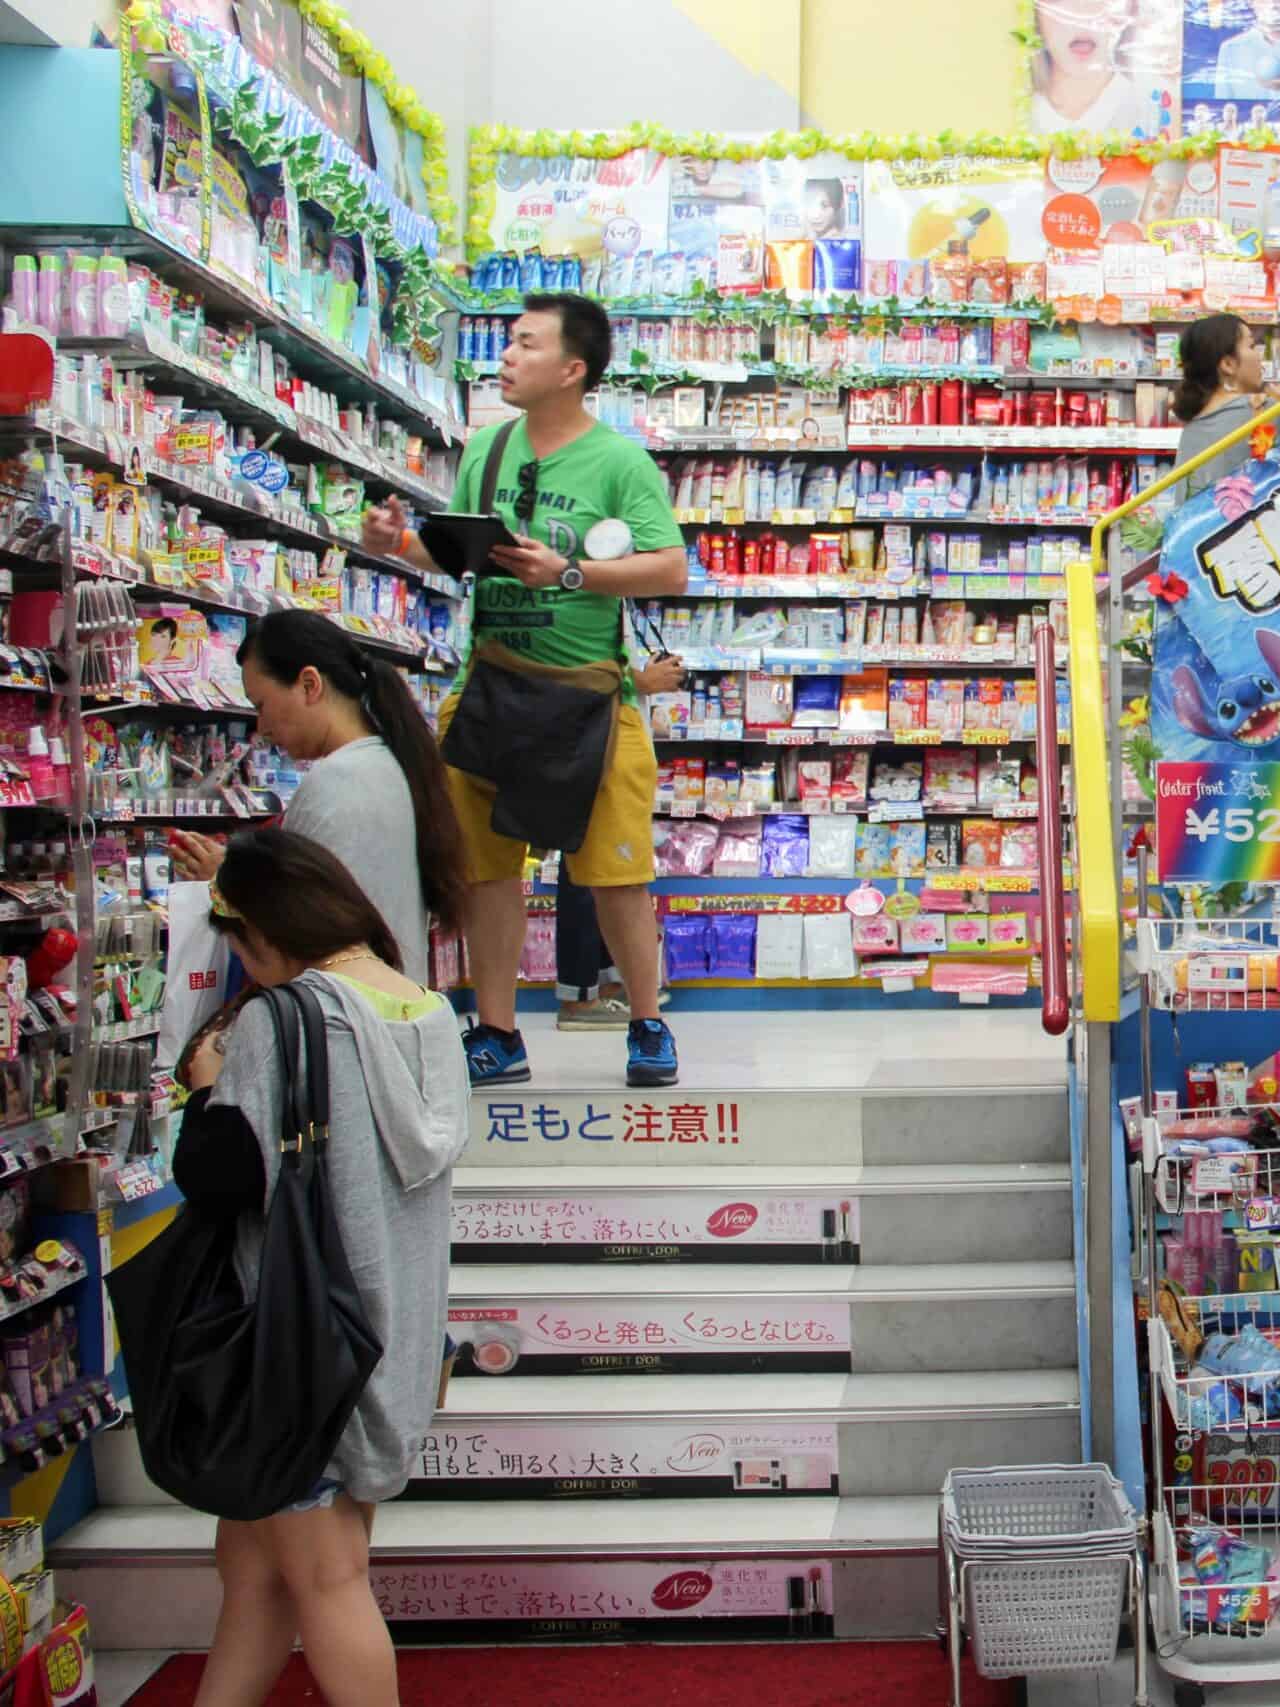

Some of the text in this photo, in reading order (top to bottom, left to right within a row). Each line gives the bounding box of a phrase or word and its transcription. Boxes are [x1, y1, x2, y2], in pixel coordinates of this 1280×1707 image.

[1159, 774, 1225, 801] Water front
[486, 1102, 740, 1145] 足もと注意!!
[455, 1218, 703, 1242] うるおいまで、落ちにくい。
[716, 1206, 754, 1230] New
[681, 1441, 720, 1461] New
[666, 1578, 706, 1598] New
[1217, 1593, 1262, 1608] ¥525
